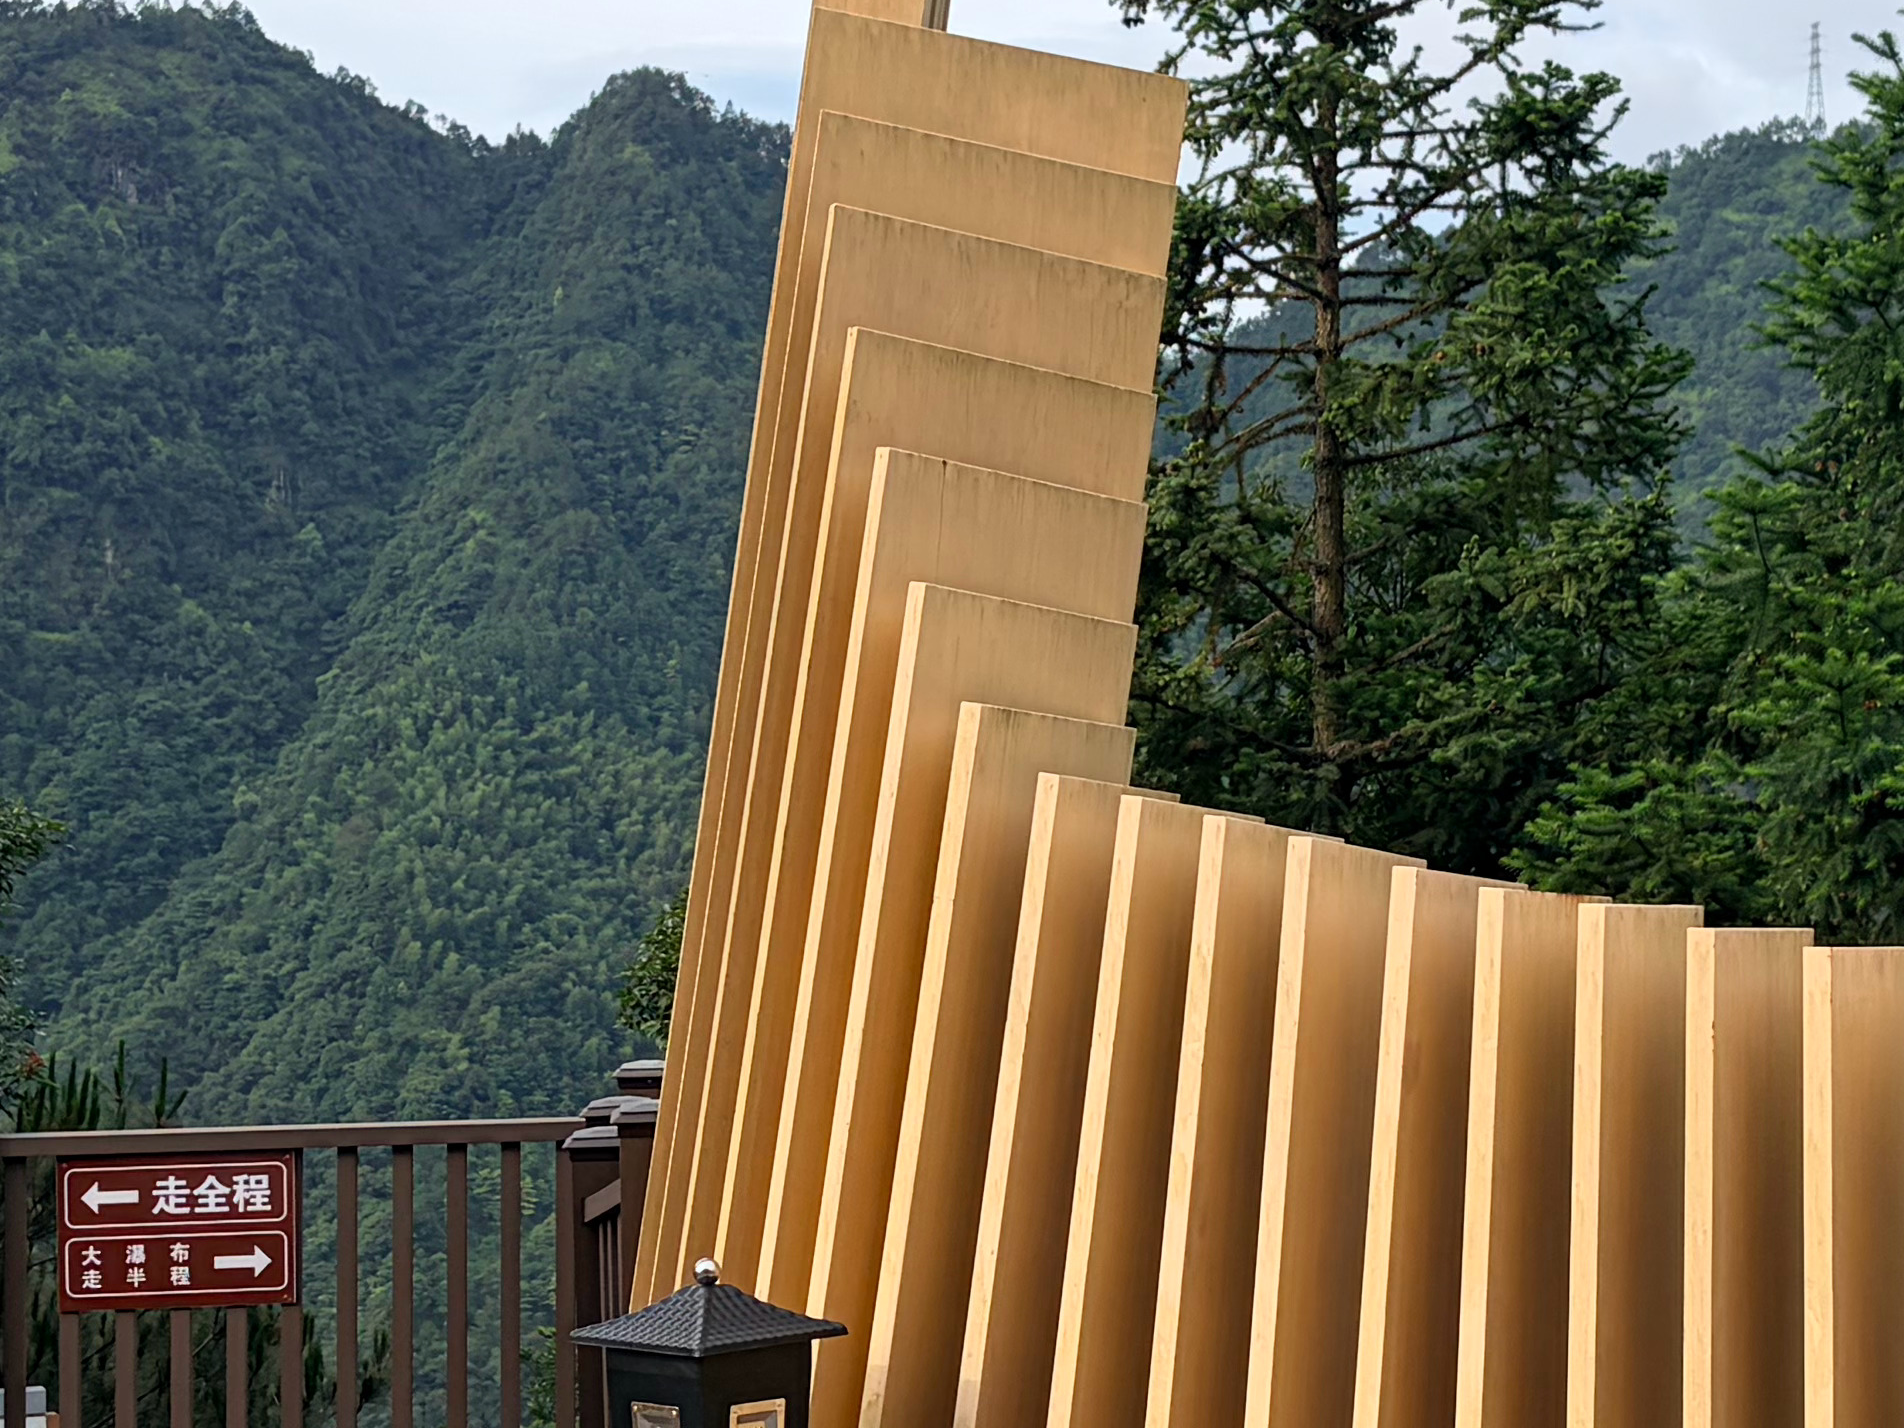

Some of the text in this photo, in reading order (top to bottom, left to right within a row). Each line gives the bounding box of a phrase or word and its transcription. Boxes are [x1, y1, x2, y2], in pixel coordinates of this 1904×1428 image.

[151, 1174, 272, 1216] 走全程
[81, 1242, 191, 1266] 大瀑布
[81, 1266, 191, 1289] 走半程
